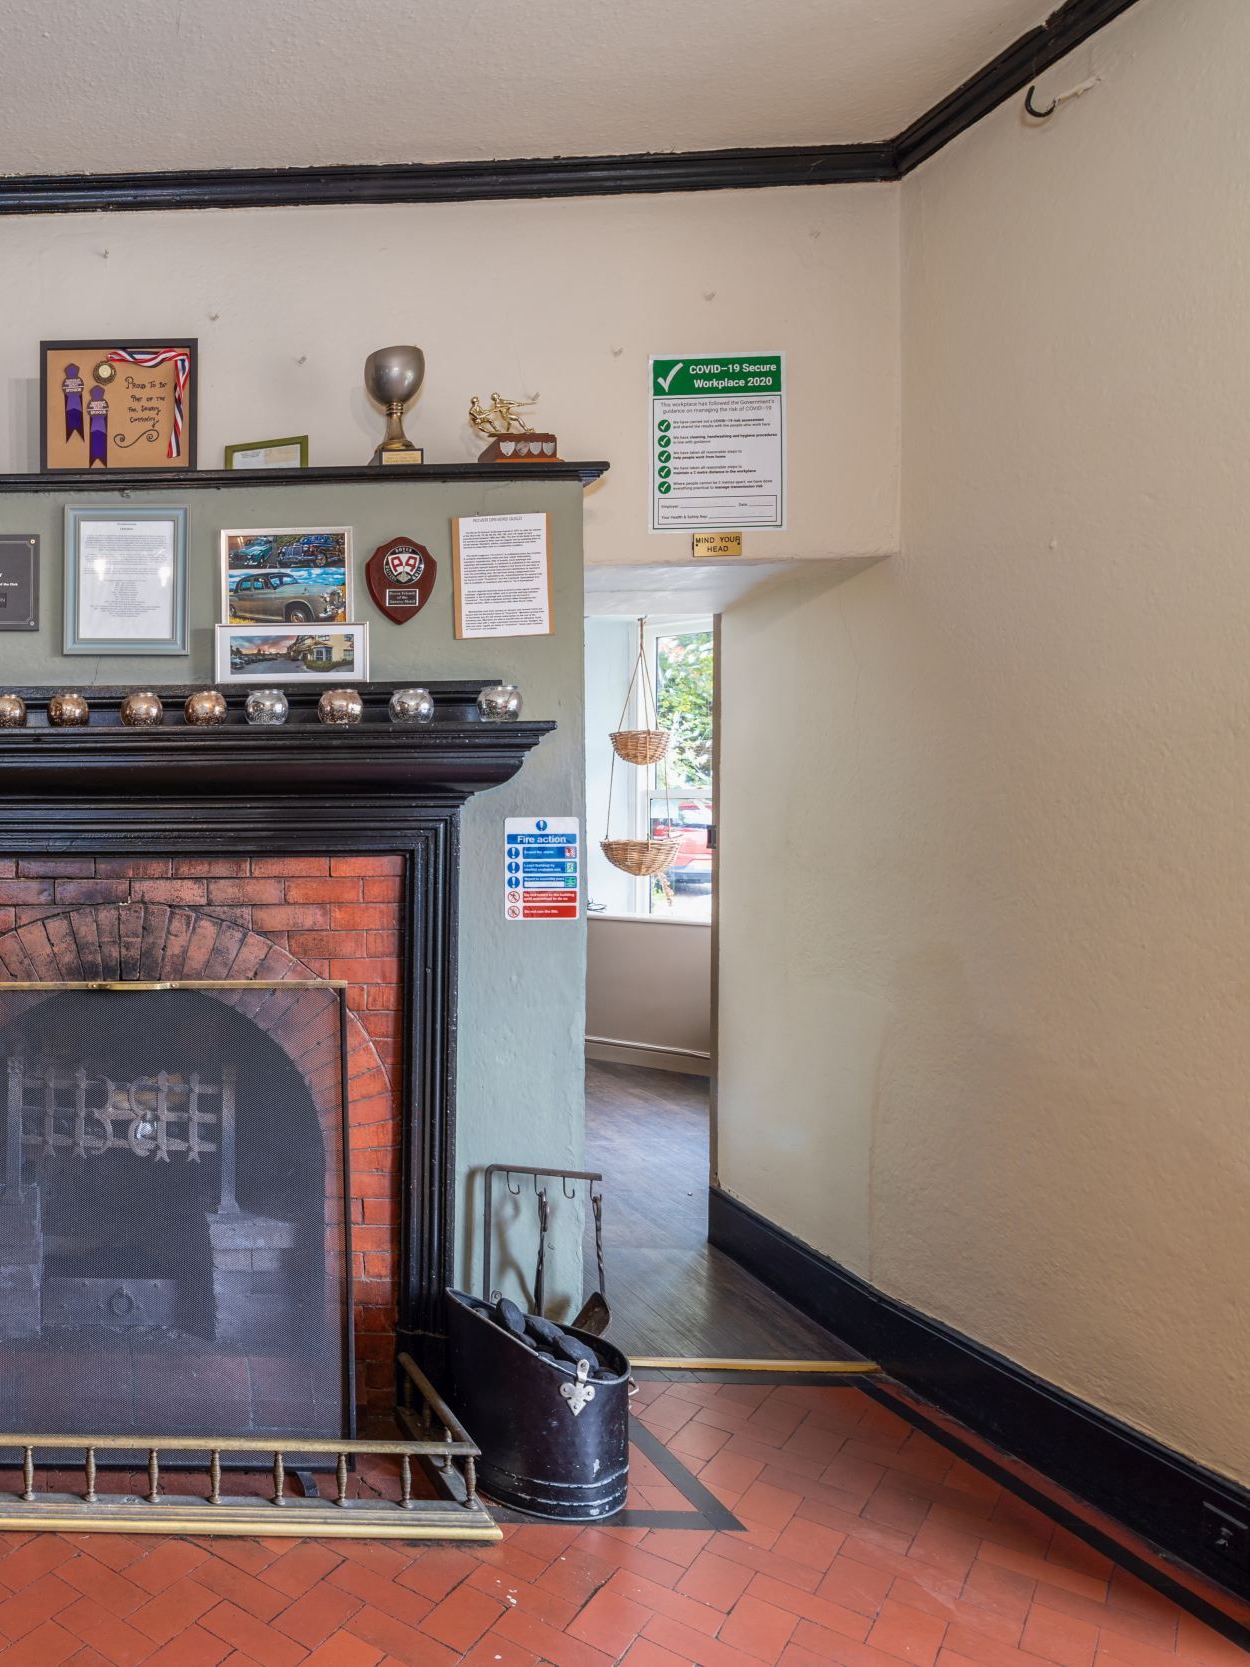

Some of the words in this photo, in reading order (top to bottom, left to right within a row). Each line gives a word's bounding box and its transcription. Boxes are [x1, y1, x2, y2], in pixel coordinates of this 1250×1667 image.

[690, 364, 740, 374] COVID-19
[694, 379, 745, 389] Workplace
[748, 377, 772, 386] 2020
